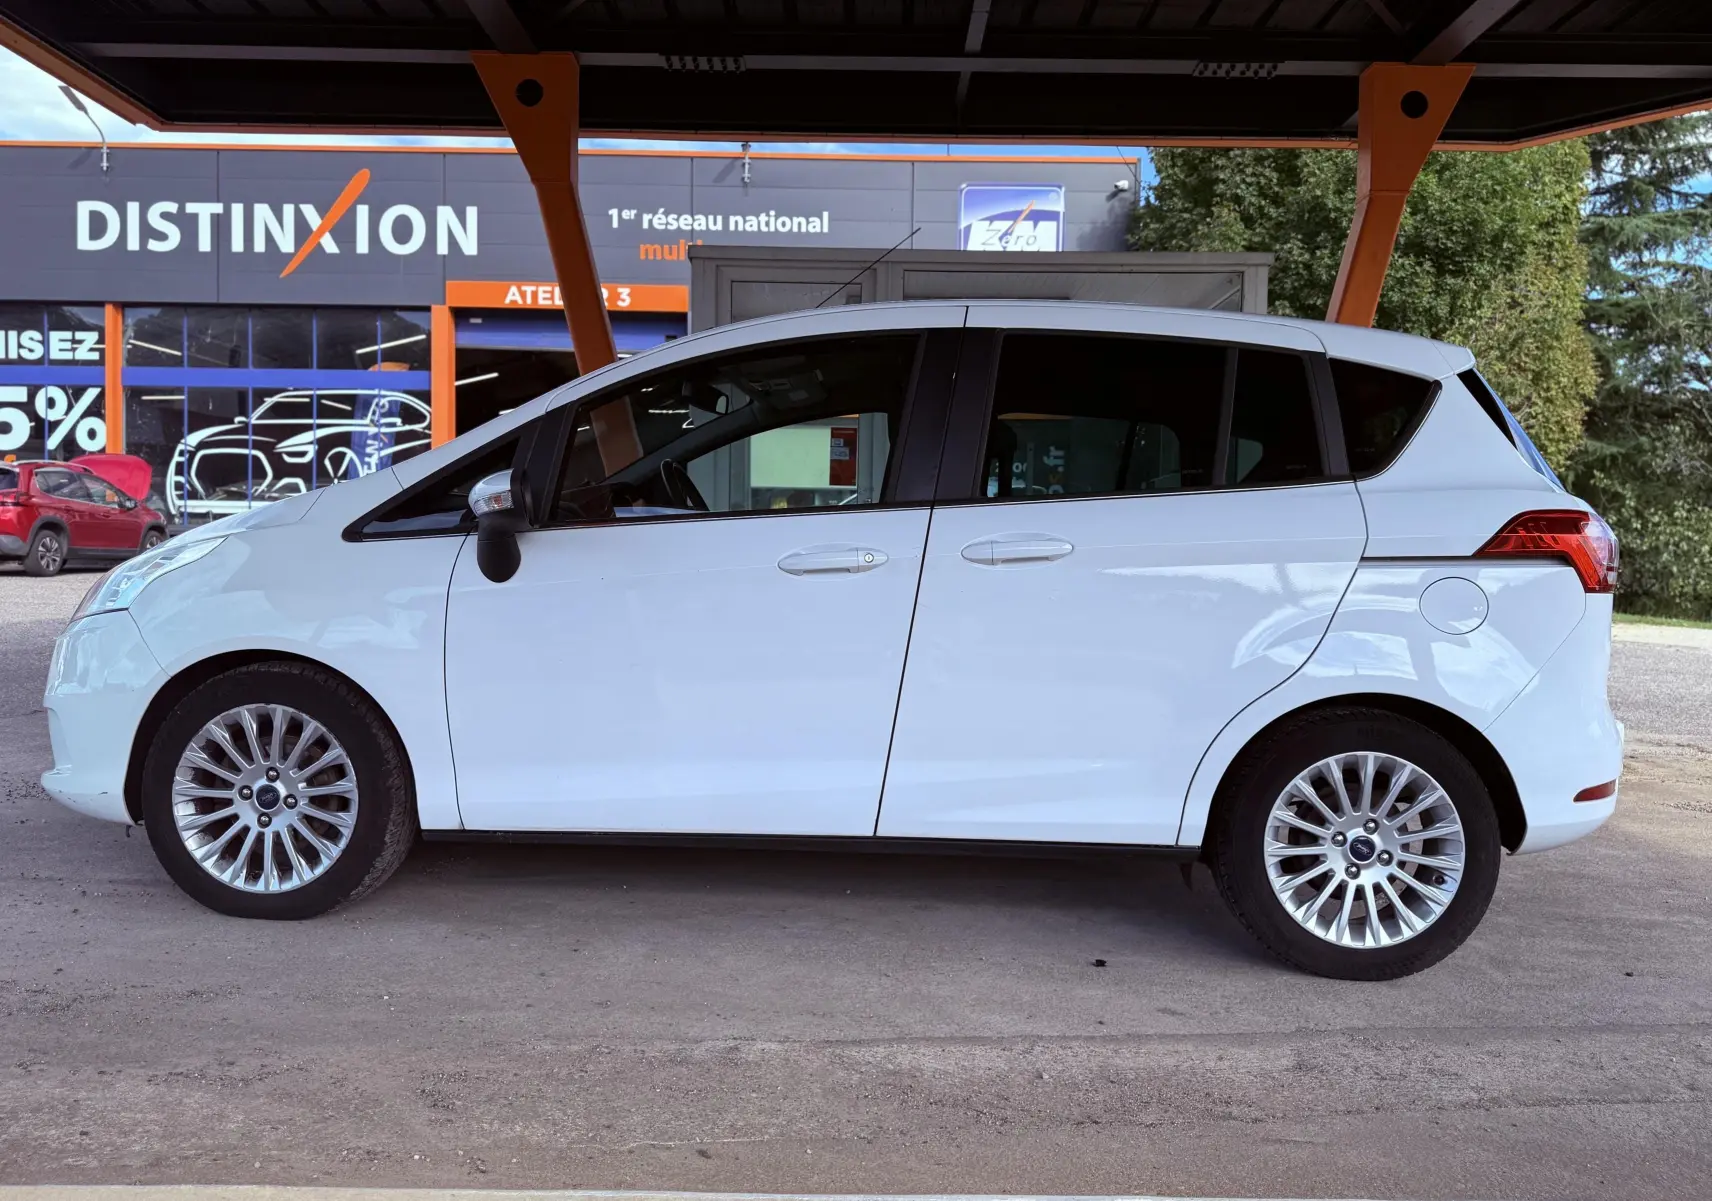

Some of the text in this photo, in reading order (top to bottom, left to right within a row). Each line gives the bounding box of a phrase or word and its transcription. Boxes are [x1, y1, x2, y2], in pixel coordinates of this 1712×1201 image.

[642, 208, 723, 231] réseau
[729, 211, 829, 233] national
[616, 287, 631, 306] 3
